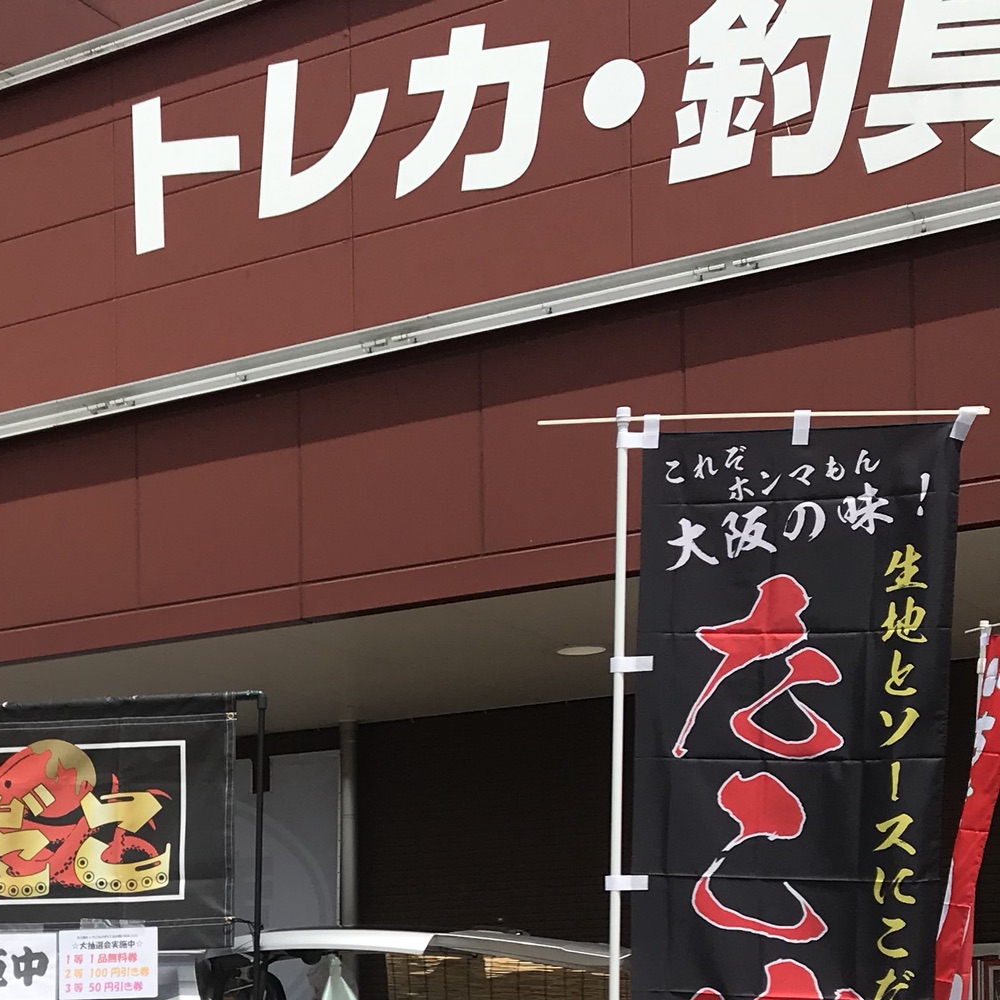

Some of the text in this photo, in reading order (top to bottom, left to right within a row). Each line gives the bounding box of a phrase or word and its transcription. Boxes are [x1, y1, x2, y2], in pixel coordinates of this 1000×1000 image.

[664, 446, 748, 484] これぞ
[728, 450, 881, 502] ホンマもん
